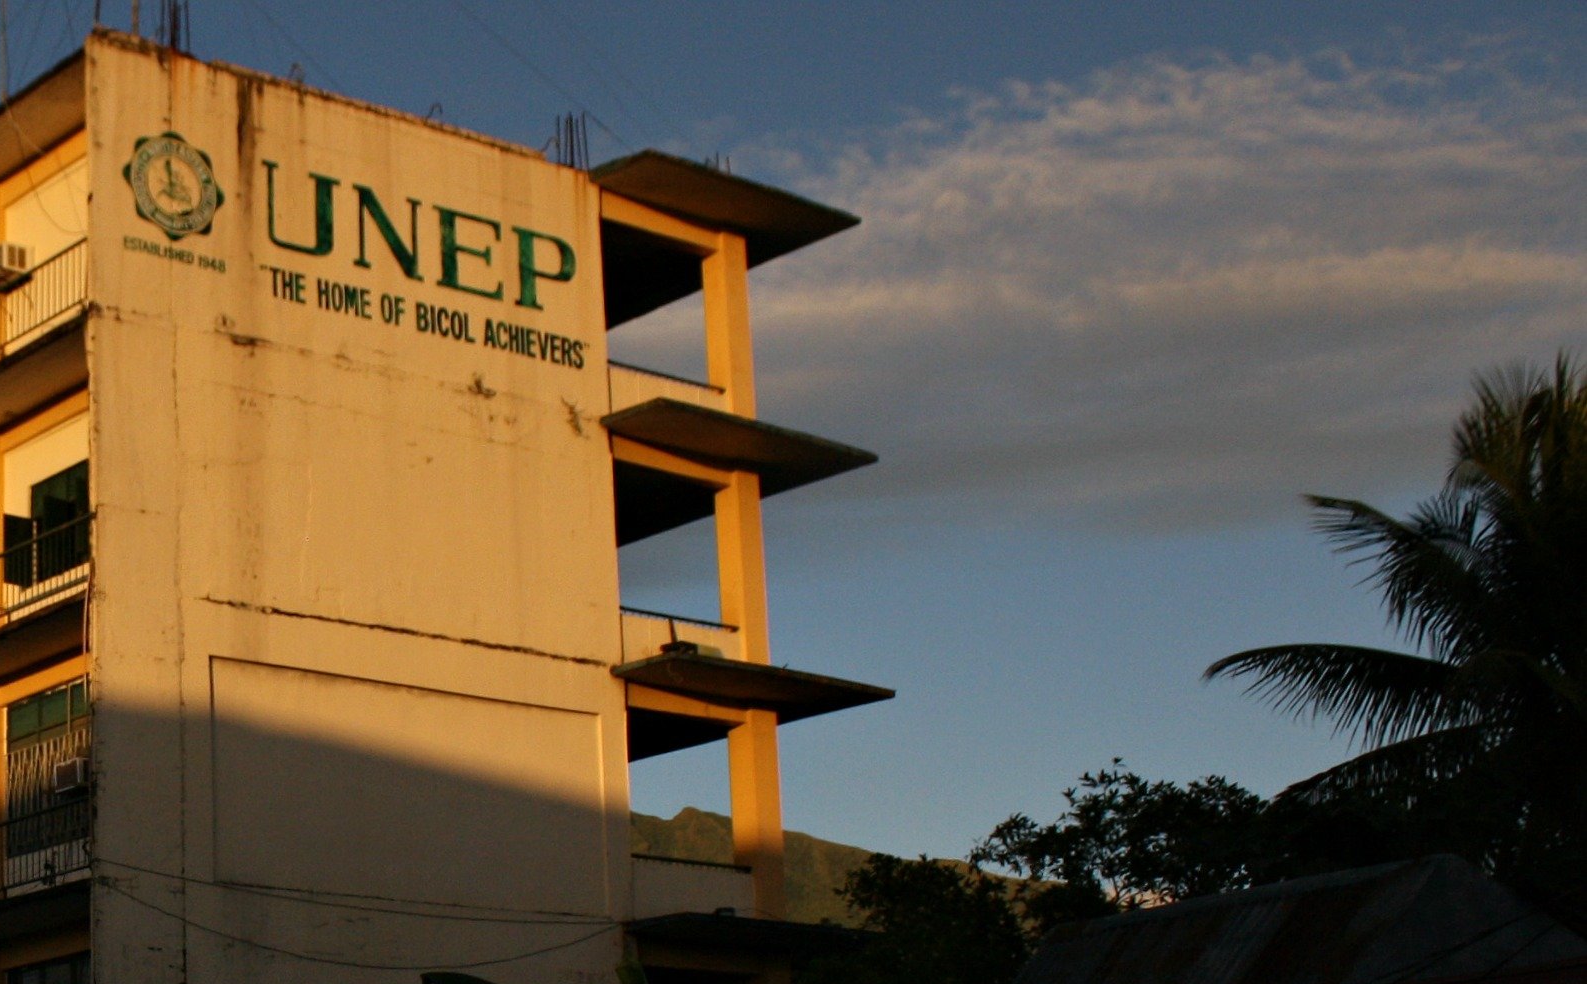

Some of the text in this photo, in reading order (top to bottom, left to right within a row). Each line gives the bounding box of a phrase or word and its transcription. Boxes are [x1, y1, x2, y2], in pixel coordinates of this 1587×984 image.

[123, 236, 194, 264] ESTABLISHED
[262, 159, 576, 311] UNEP
[317, 278, 372, 320] HOME
[380, 293, 406, 326] OF
[416, 302, 475, 343] BICOL
